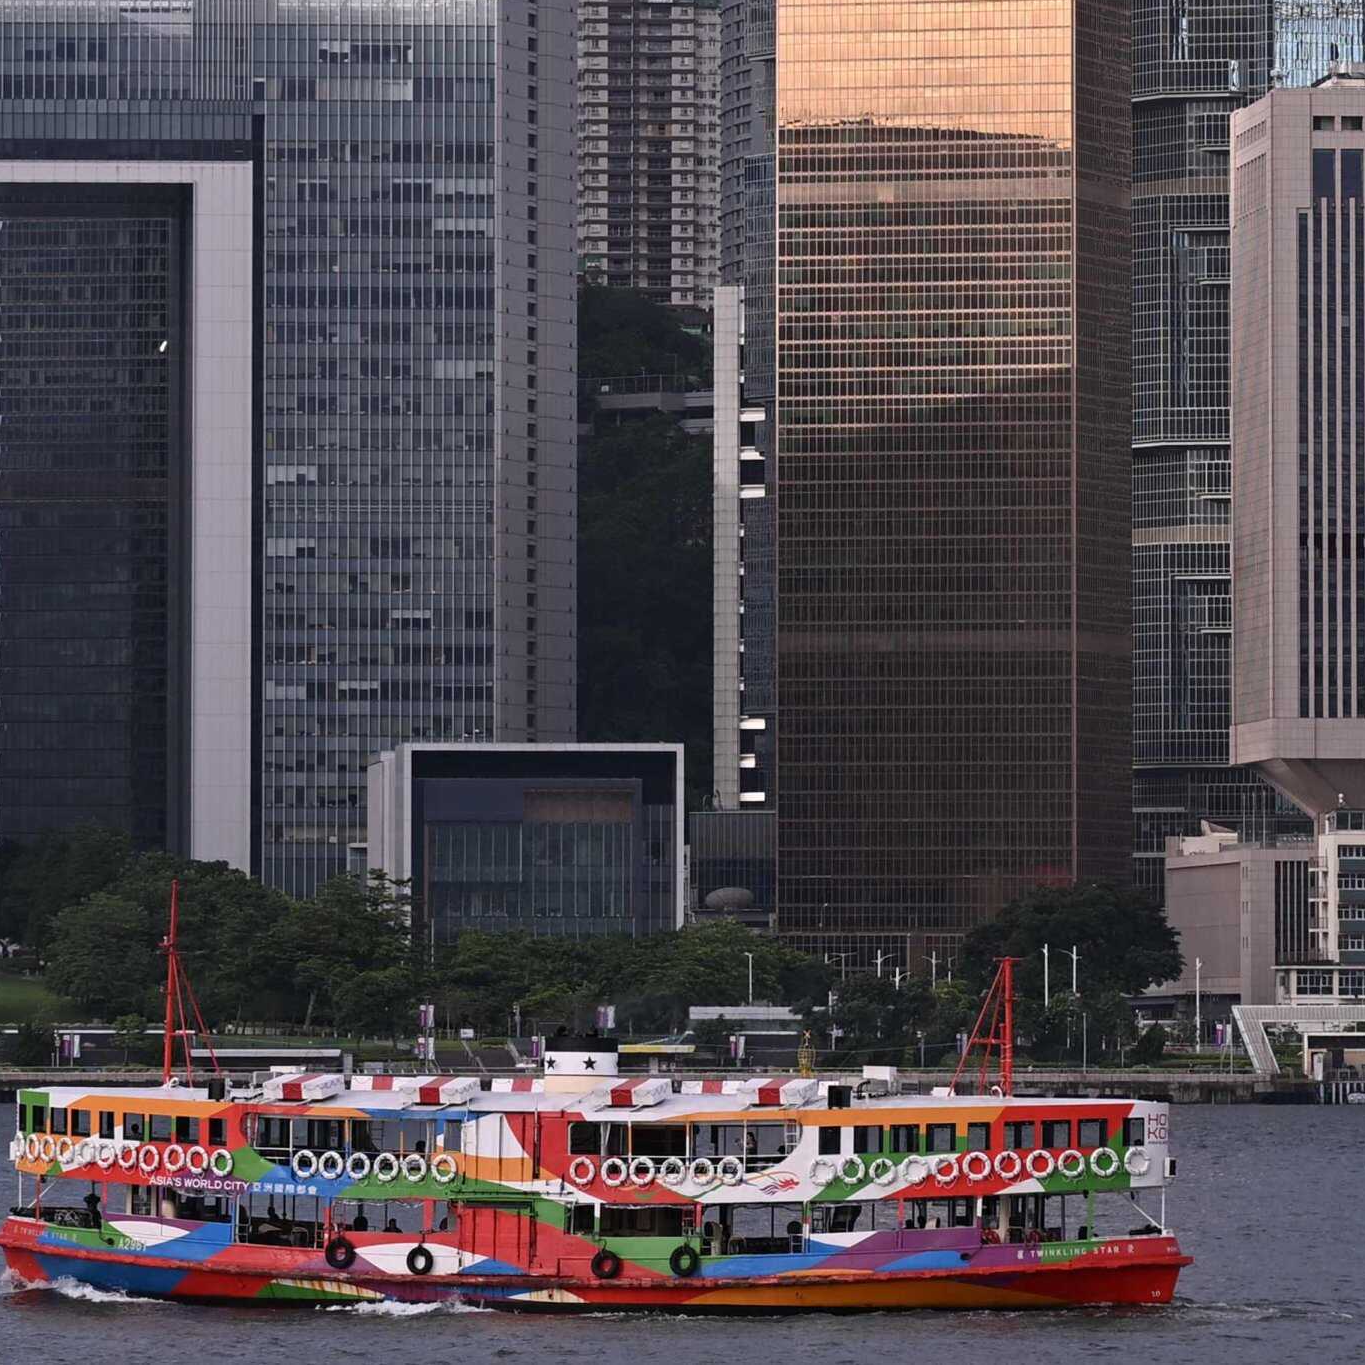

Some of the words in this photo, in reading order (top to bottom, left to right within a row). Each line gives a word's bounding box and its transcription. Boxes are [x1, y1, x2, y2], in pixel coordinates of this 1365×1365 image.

[149, 1175, 182, 1187] ASIA'S
[184, 1177, 222, 1190] WORLD
[223, 1180, 250, 1191] CITY
[1030, 1247, 1087, 1258] TWINKLING
[1094, 1245, 1120, 1255] STAR
